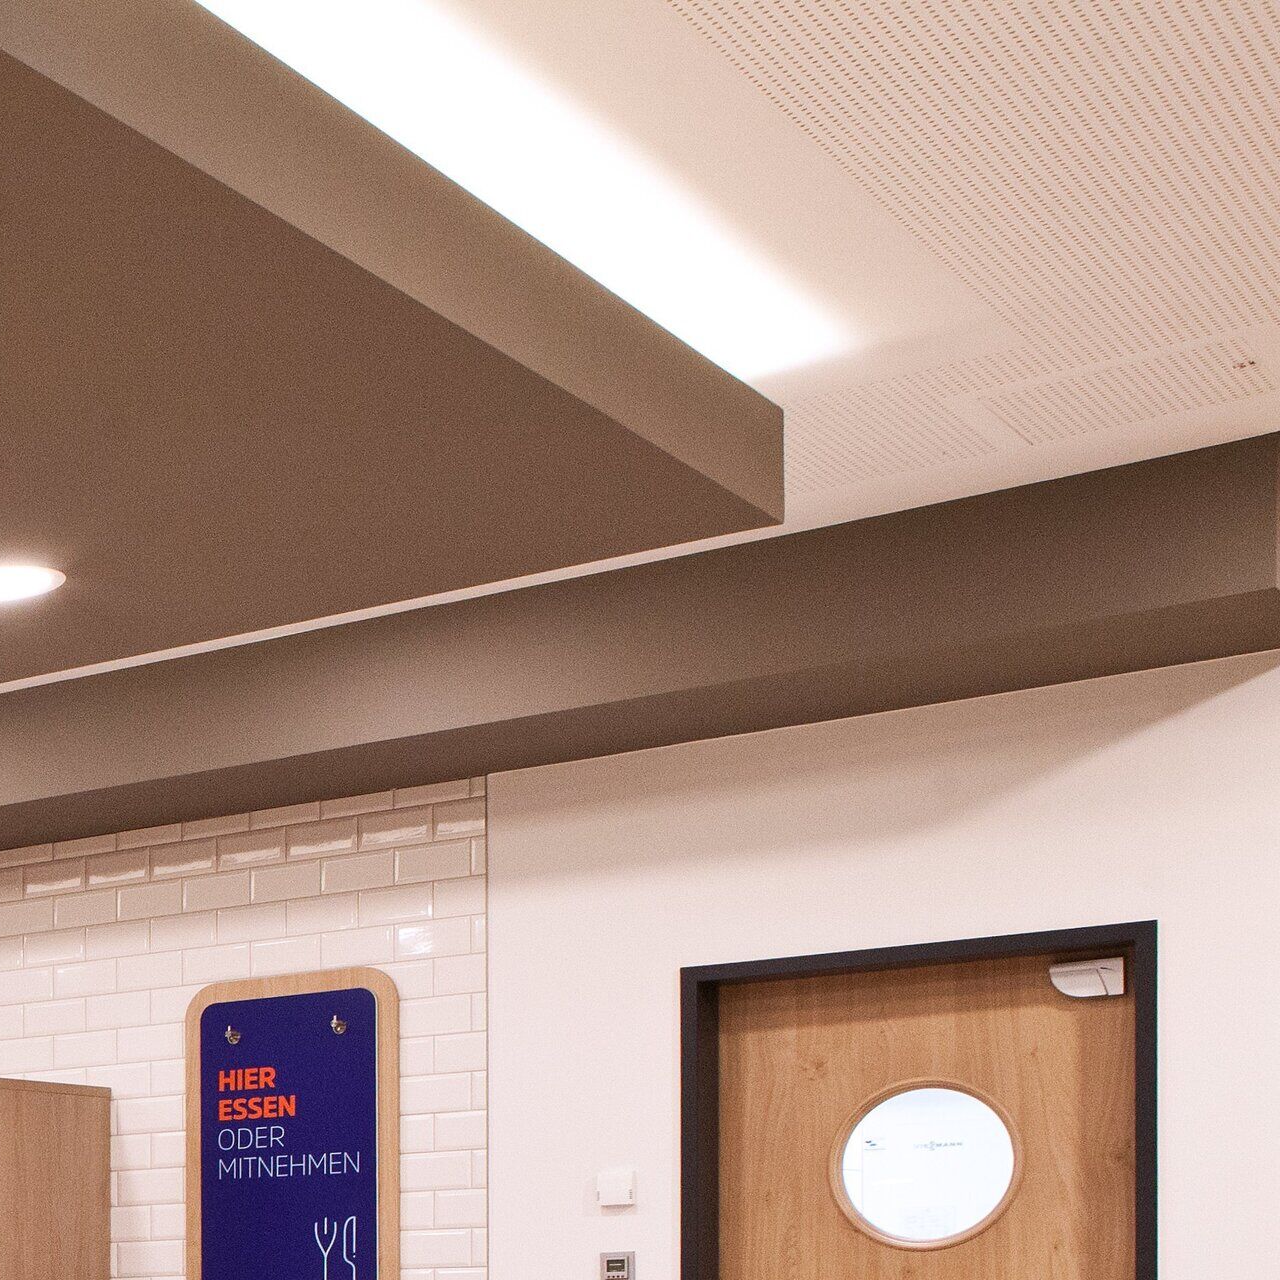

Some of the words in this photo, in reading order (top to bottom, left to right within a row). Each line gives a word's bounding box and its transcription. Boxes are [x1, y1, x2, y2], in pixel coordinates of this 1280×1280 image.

[218, 1066, 276, 1092] HIER
[218, 1094, 296, 1121] ESSEN
[218, 1125, 285, 1151] ODER
[218, 1151, 360, 1180] MITNEHMEN
